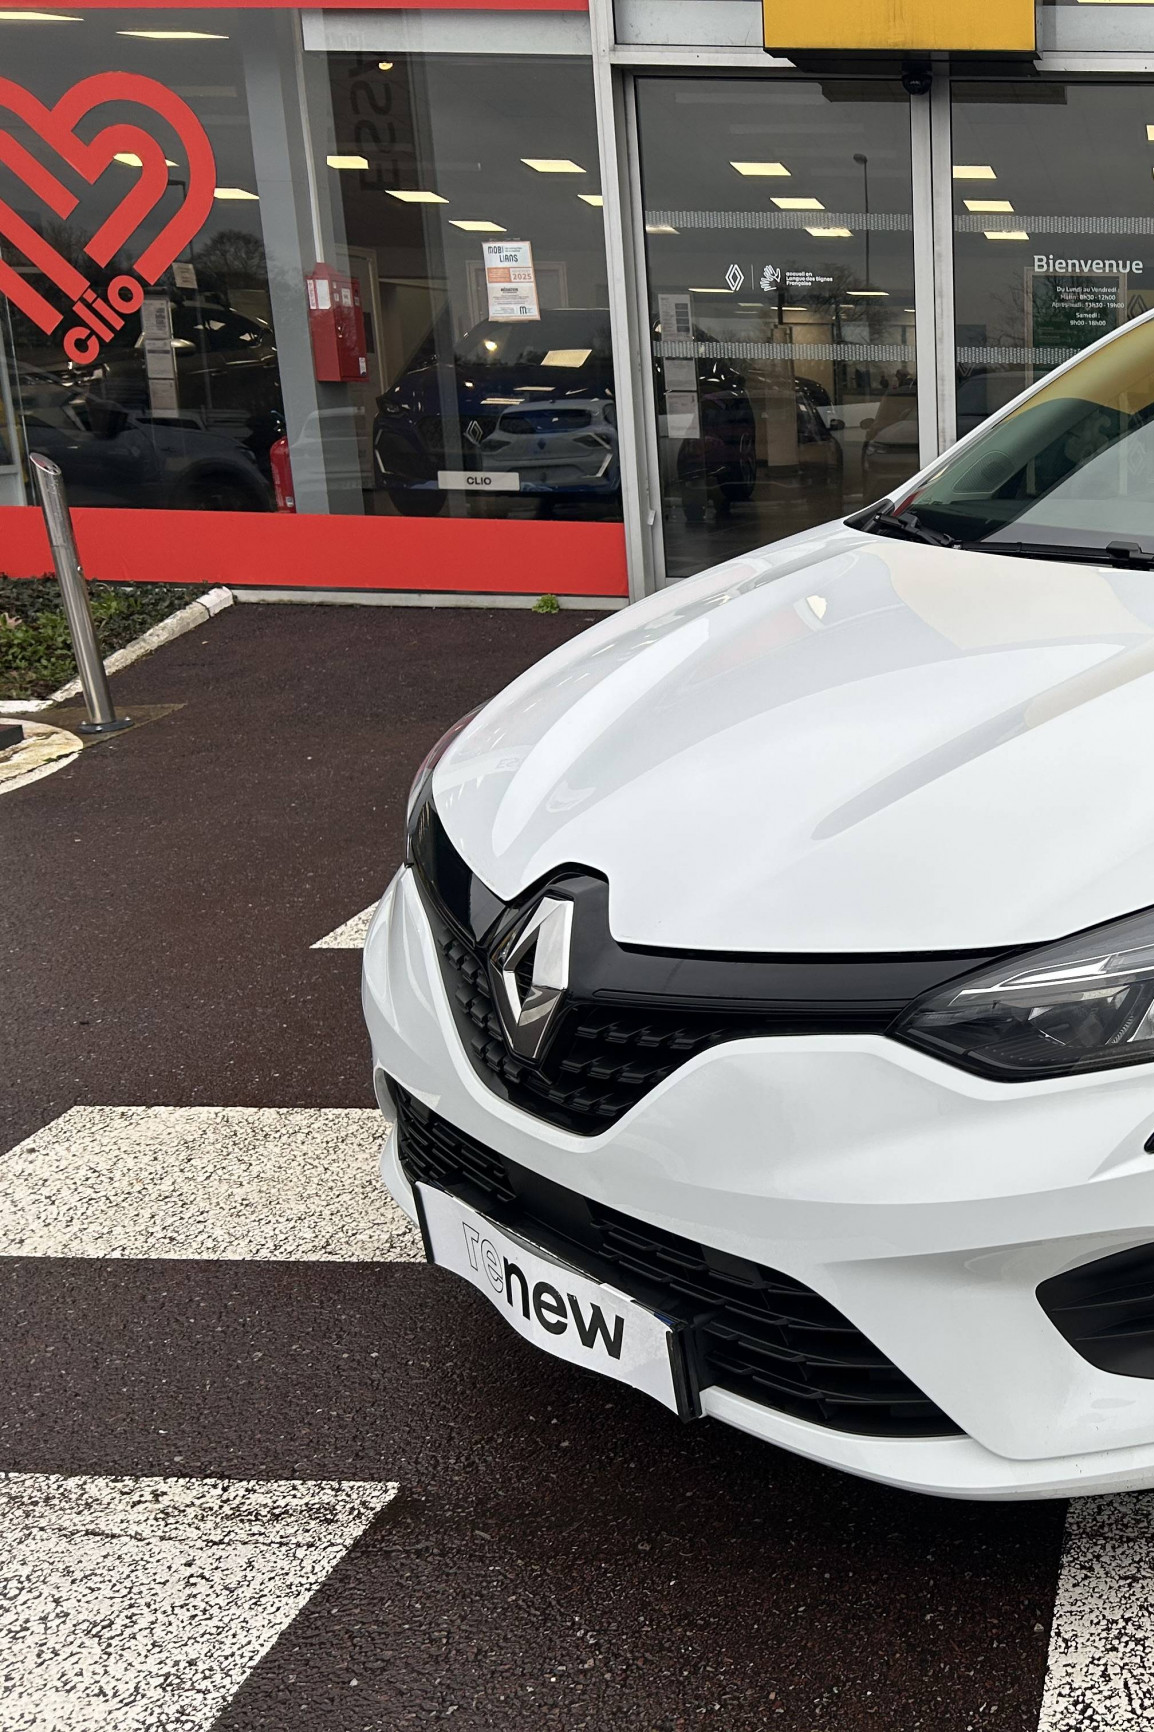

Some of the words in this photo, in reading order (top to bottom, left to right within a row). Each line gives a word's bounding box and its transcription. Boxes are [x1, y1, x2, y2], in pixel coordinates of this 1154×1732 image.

[1033, 254, 1144, 274] Bienvenue
[512, 273, 532, 281] 2025
[63, 274, 145, 365] clio
[466, 476, 492, 486] CLIO
[462, 1220, 626, 1361] renew
